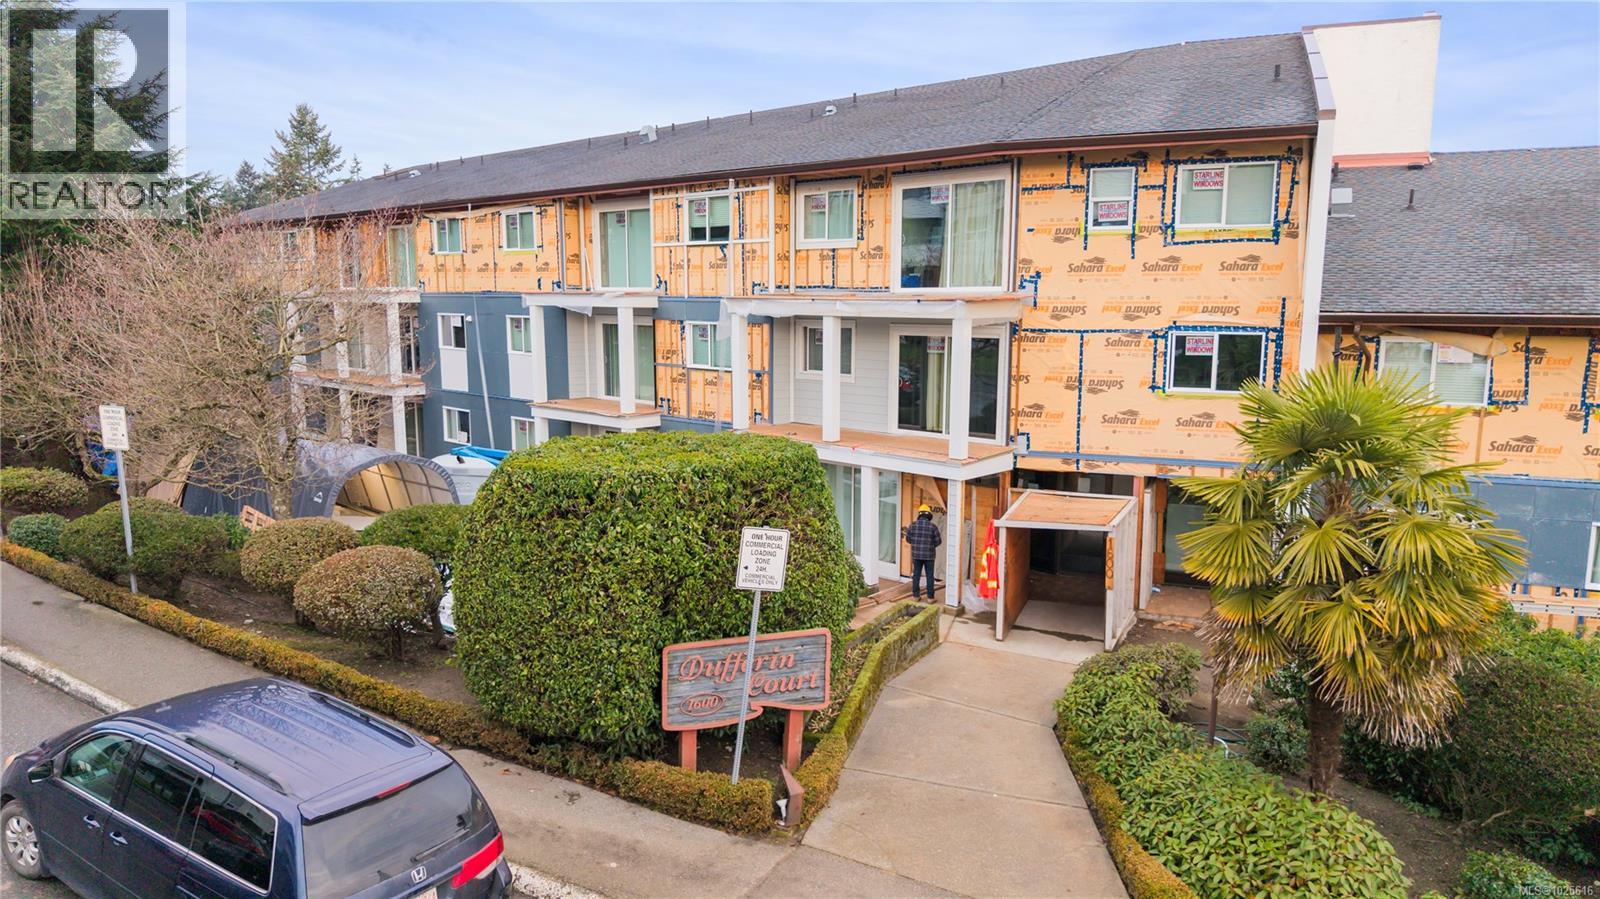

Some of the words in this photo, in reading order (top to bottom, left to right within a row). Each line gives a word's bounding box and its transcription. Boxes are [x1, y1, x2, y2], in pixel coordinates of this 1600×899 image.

[1194, 170, 1224, 179] STARLINE
[1193, 180, 1224, 188] WINDOWS
[1067, 262, 1104, 273] Sahara
[1141, 262, 1179, 272] Sahara
[1181, 263, 1202, 272] Excel
[1218, 260, 1259, 272] Sahara
[1260, 262, 1285, 272] Excel
[1051, 305, 1087, 315] Sahara
[1125, 305, 1162, 315] Sahara
[1201, 305, 1240, 316] Sahara
[1104, 337, 1142, 348] Sahara
[1088, 379, 1125, 390] Sahara
[1100, 414, 1137, 425] Sahara
[1175, 416, 1213, 428] Sahara
[1488, 440, 1535, 453] Sahara
[1535, 445, 1563, 455] Excel
[752, 533, 763, 541] ONE
[745, 541, 784, 550] COMMERCIAL
[749, 671, 817, 696] Court
